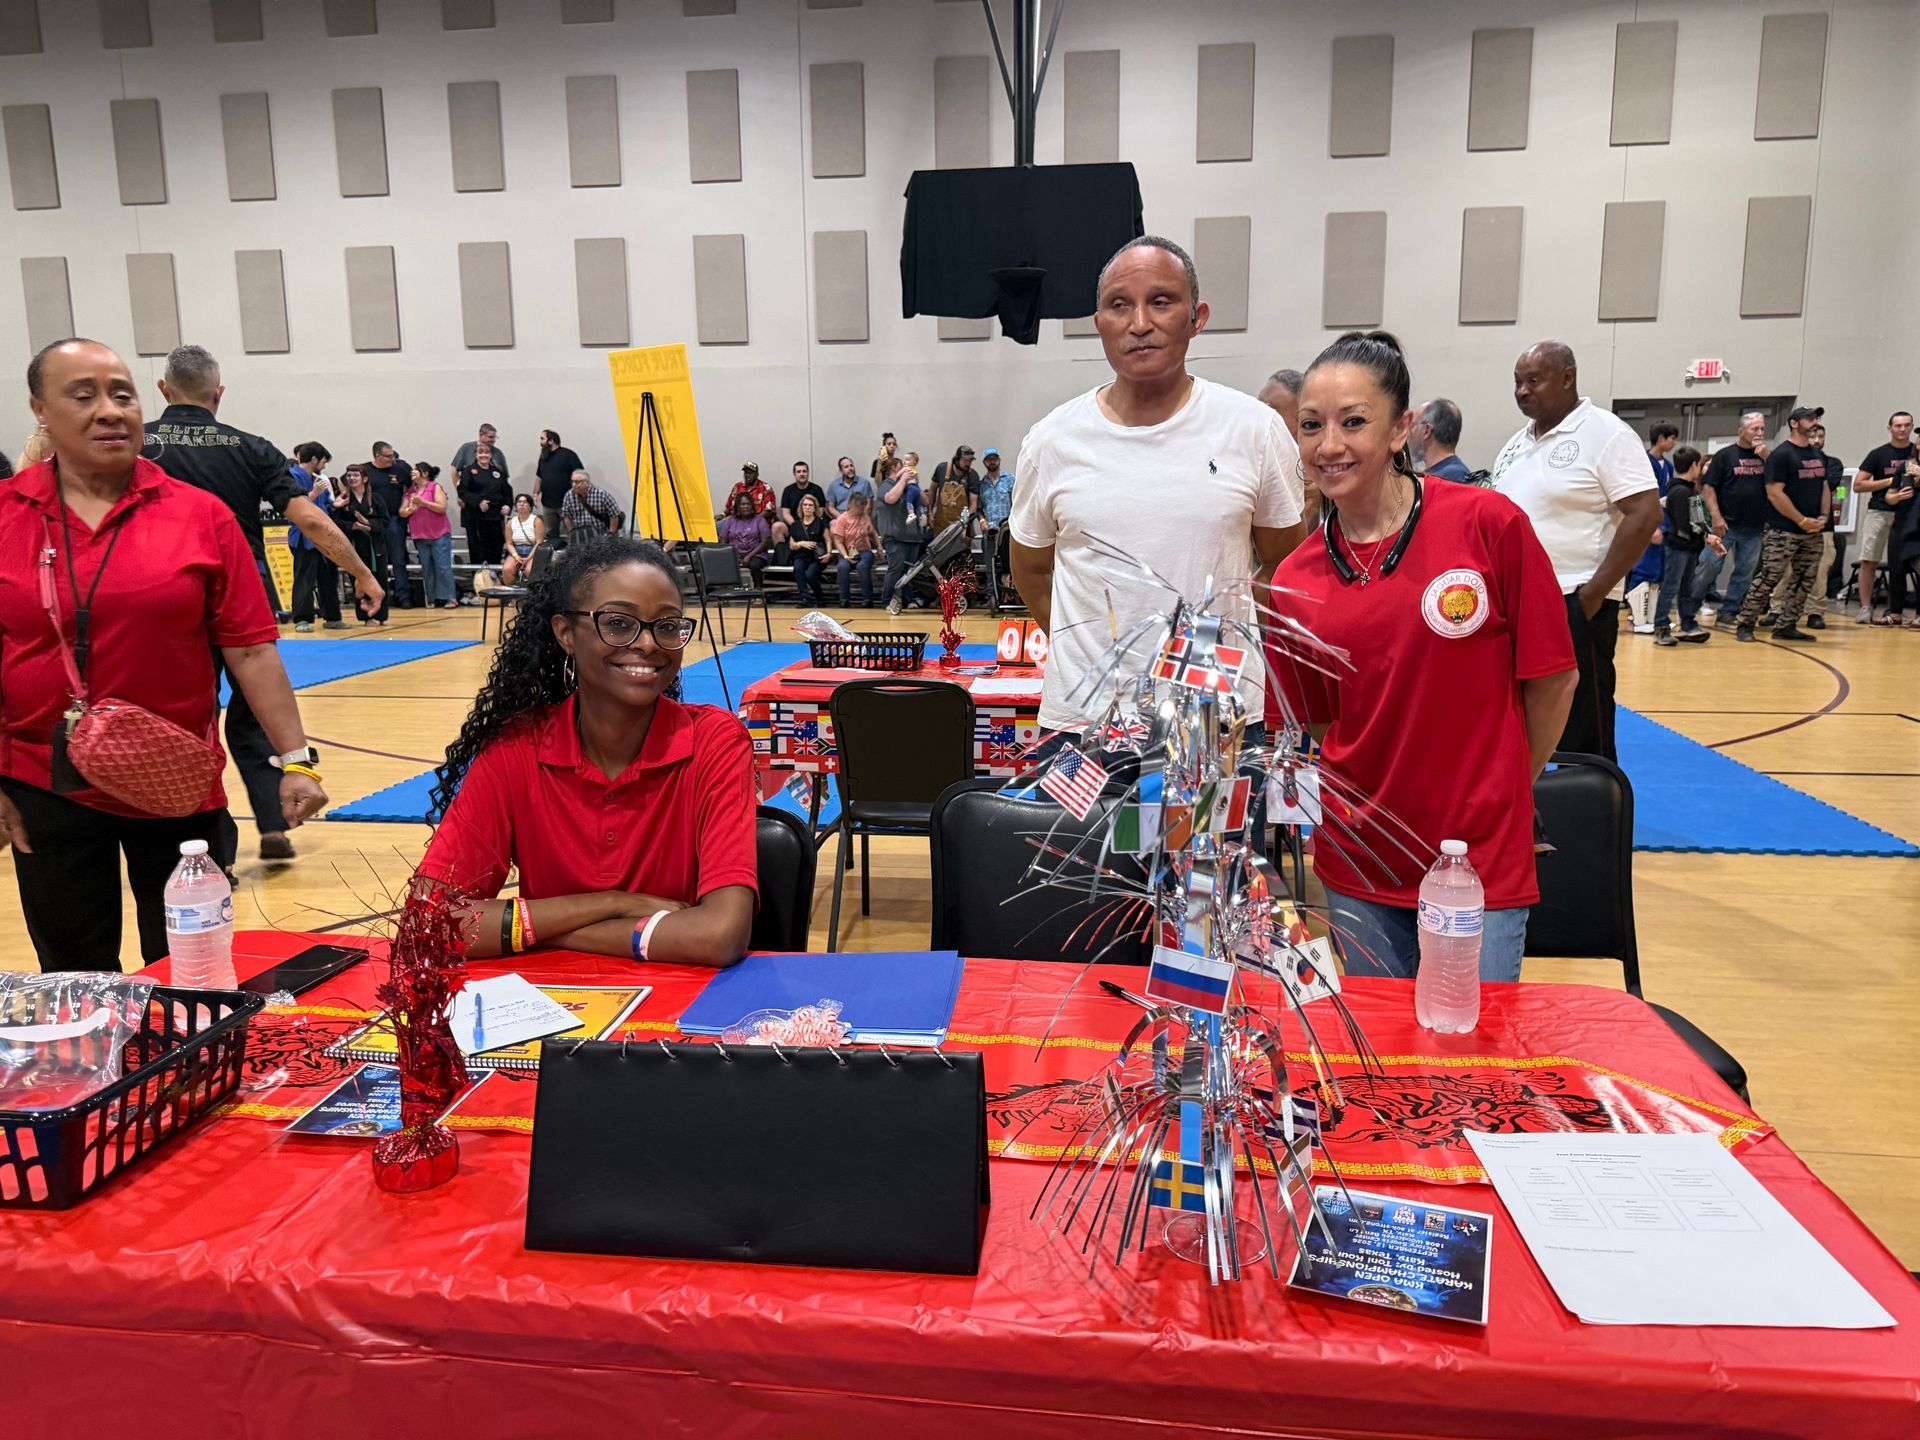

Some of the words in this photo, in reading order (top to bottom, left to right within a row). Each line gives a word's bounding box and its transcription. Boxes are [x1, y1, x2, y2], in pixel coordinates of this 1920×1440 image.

[1698, 361, 1719, 377] EXIT
[158, 424, 218, 435] ELITE
[143, 433, 241, 447] BREAKERS
[1431, 575, 1461, 598] JAGUAR
[1464, 575, 1485, 594] DOJO
[1354, 1234, 1380, 1242] Center
[1417, 1230, 1449, 1240] Register
[1352, 1238, 1372, 1246] 2026
[1410, 1243, 1438, 1252] Victory
[1358, 1248, 1392, 1260] Texas
[1388, 1244, 1439, 1257] SEPTEMBER
[1309, 1254, 1415, 1279] CHAMPIONSHIPS
[1367, 1257, 1392, 1267] Toni
[1395, 1262, 1414, 1271] by:
[1355, 1270, 1390, 1283] OPEN
[1417, 1266, 1460, 1279] Hosted
[1394, 1278, 1424, 1289] KMA
[1415, 1273, 1473, 1290] KARATE
